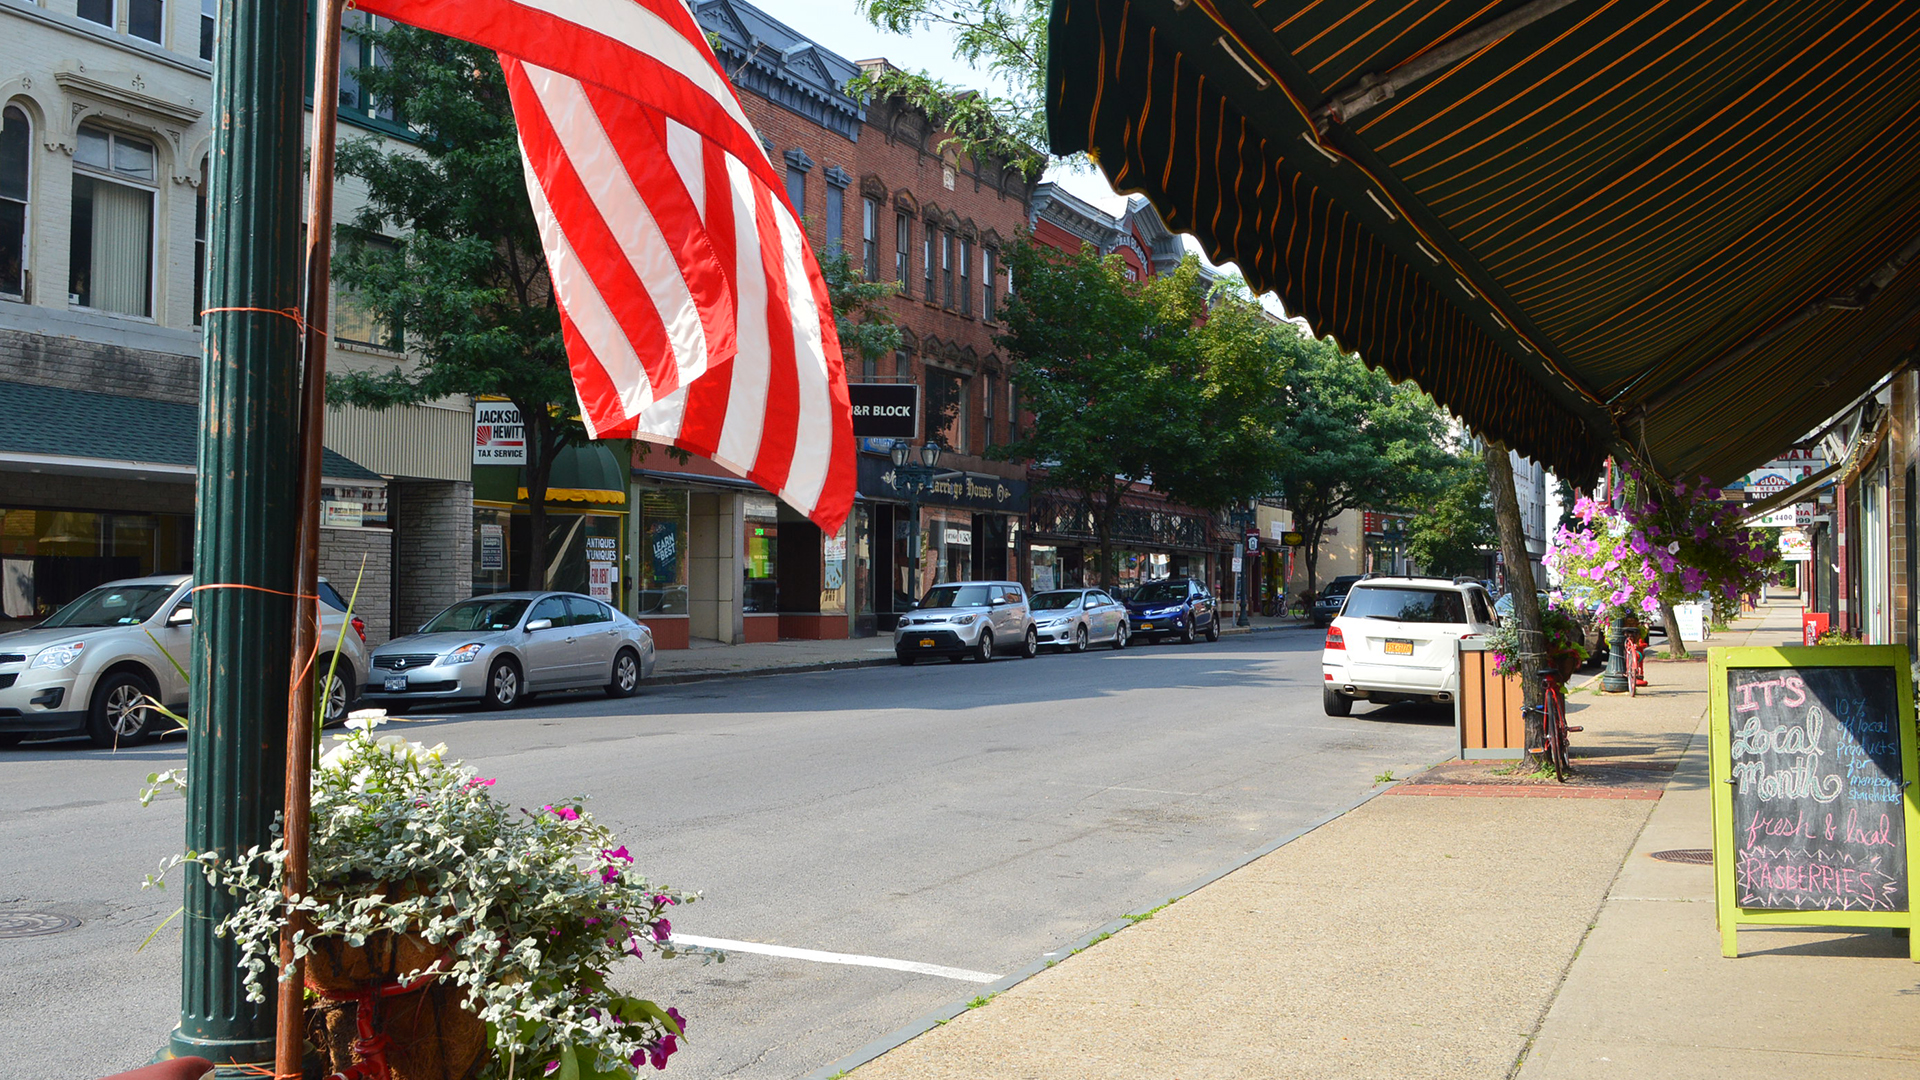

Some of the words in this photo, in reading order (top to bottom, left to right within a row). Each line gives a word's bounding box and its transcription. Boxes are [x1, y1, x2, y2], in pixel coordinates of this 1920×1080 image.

[851, 405, 870, 416] &R
[872, 405, 911, 417] BLOCK
[477, 449, 492, 458] TAX
[493, 449, 524, 458] SERVICE
[1760, 476, 1786, 485] GLOVE
[586, 537, 616, 549] ANTIQUES
[652, 532, 675, 554] LEARN
[660, 542, 676, 561] BEST
[1735, 676, 1807, 712] IT'S
[1731, 705, 1825, 760] Local
[1836, 716, 1855, 743] off
[1857, 713, 1888, 733] local
[1846, 755, 1874, 778] for
[1747, 810, 1816, 850] fresh
[1824, 813, 1837, 840] &
[1846, 808, 1895, 847] local
[1746, 857, 1875, 901] RASBERRIES
